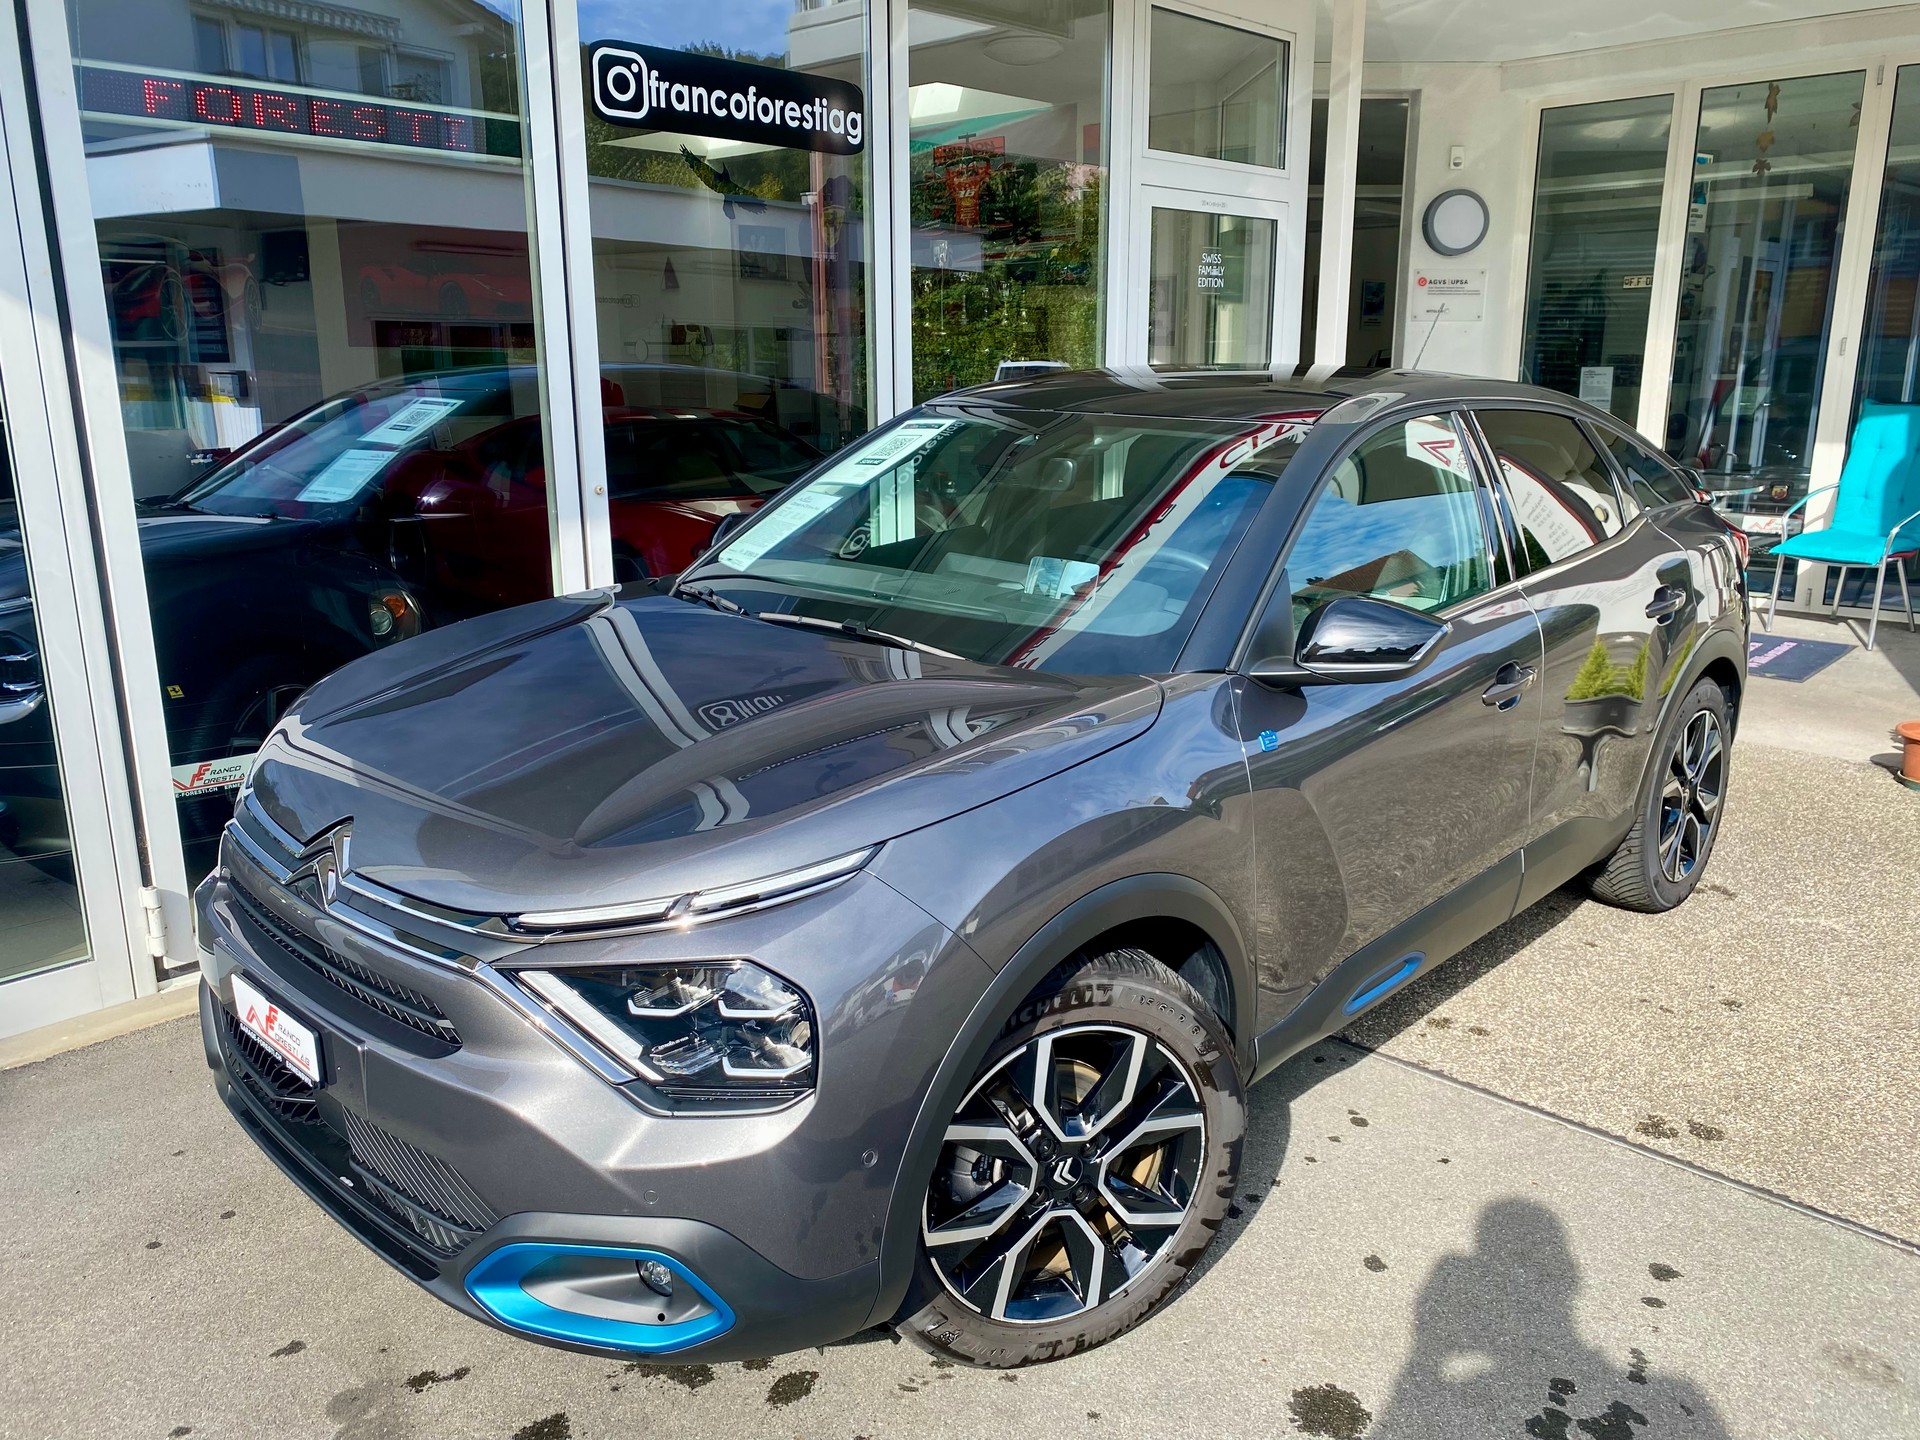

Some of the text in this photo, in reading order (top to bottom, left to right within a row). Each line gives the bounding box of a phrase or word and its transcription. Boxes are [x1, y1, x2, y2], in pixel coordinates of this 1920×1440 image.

[143, 79, 467, 147] FORESTI
[649, 69, 862, 145] francoforestiag
[1202, 252, 1222, 264] SWISS
[1197, 277, 1225, 288] EDITION
[198, 762, 242, 776] FRANCO
